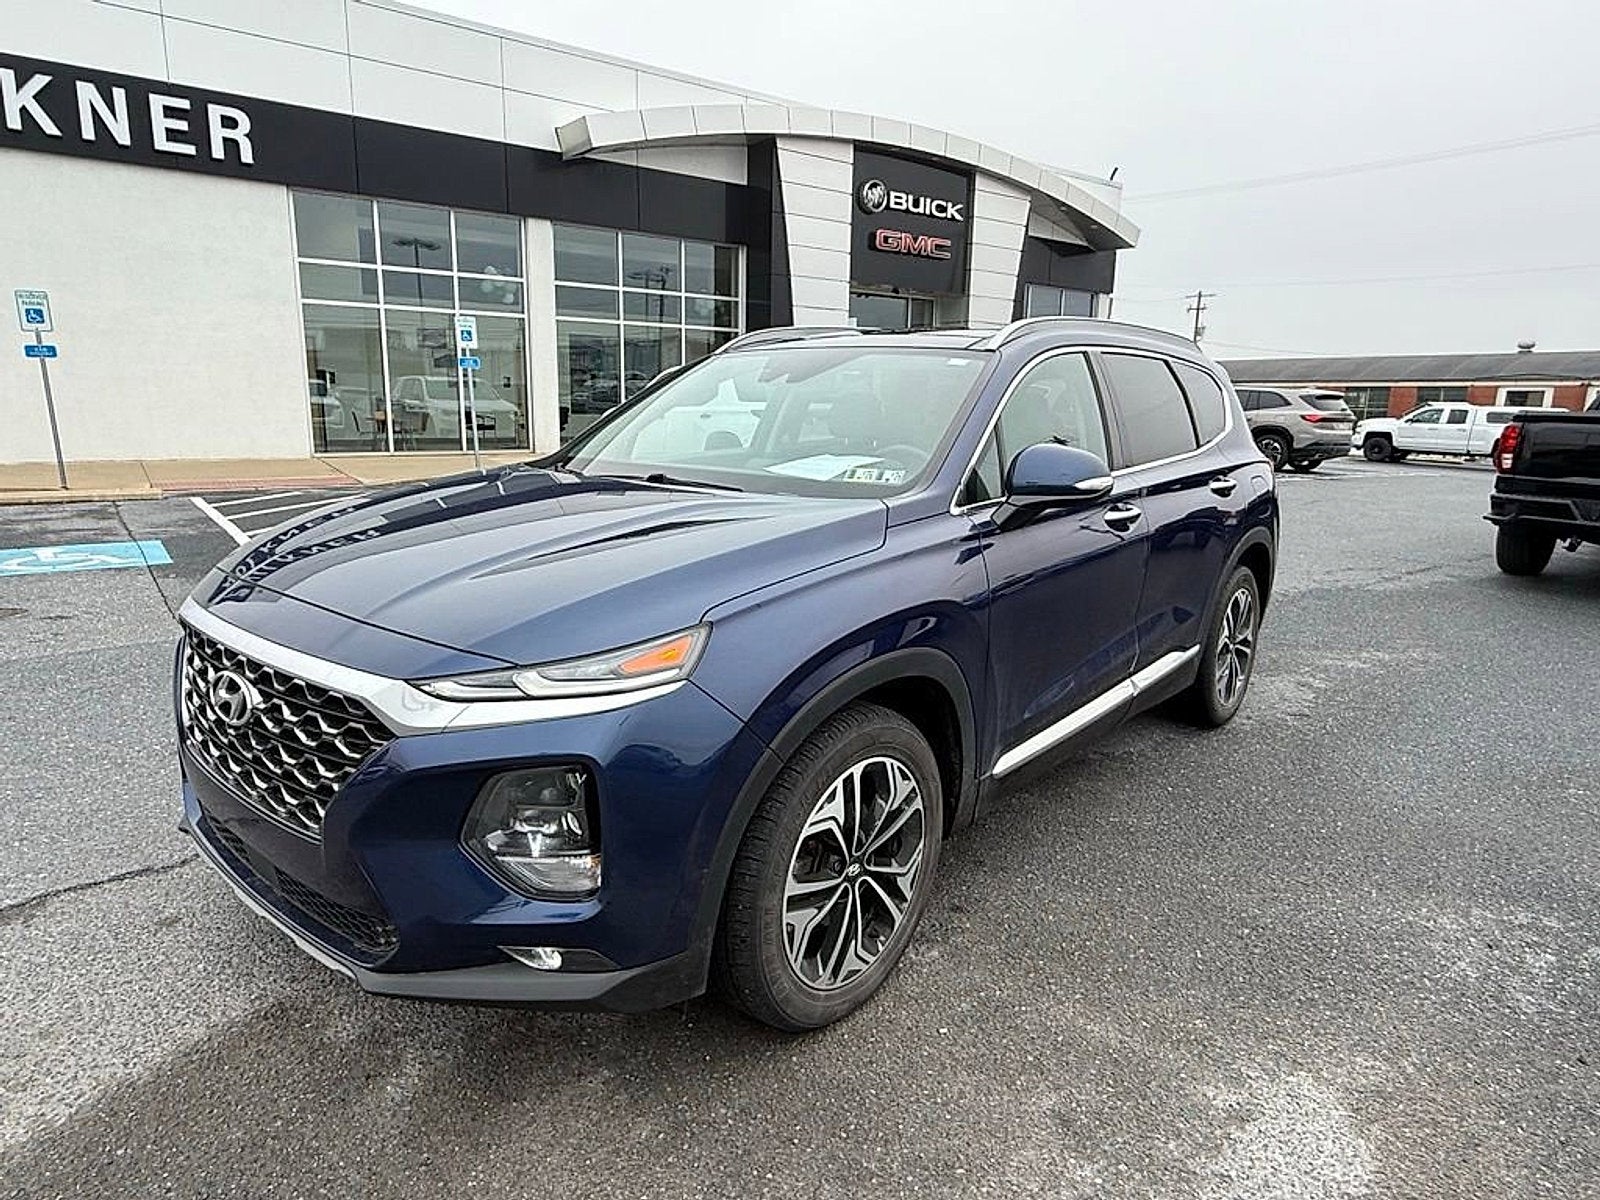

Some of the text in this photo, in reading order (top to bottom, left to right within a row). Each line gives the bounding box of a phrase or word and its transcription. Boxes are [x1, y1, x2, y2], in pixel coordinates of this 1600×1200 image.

[0, 67, 254, 164] KNER
[889, 190, 964, 221] BUICK
[875, 229, 952, 259] GMC
